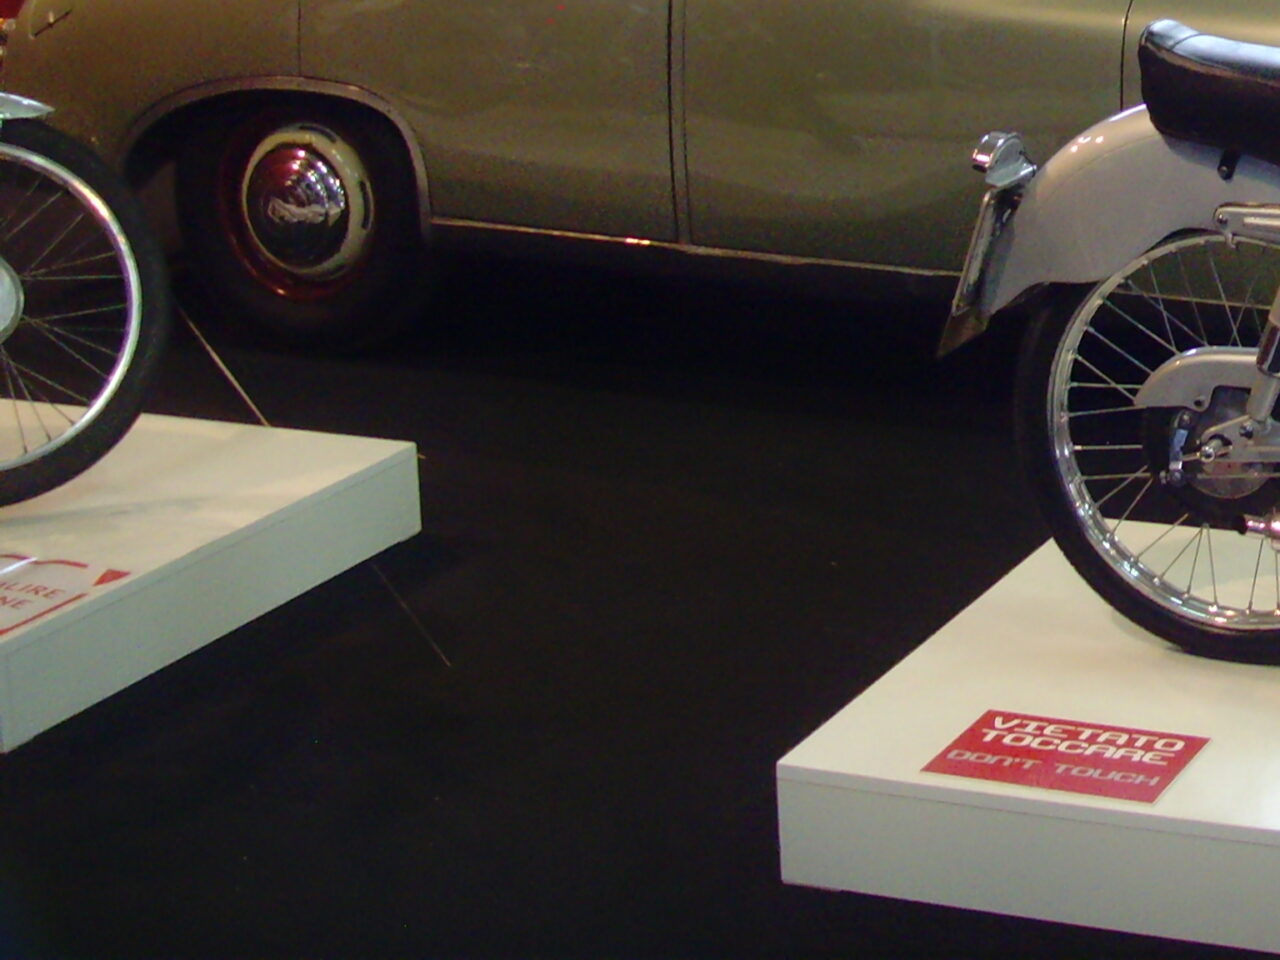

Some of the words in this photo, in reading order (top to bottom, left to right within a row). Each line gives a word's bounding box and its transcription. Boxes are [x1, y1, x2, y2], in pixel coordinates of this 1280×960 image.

[982, 728, 1175, 765] TOCCARE
[994, 716, 1185, 751] VIETATO
[1055, 763, 1160, 787] TOUCH
